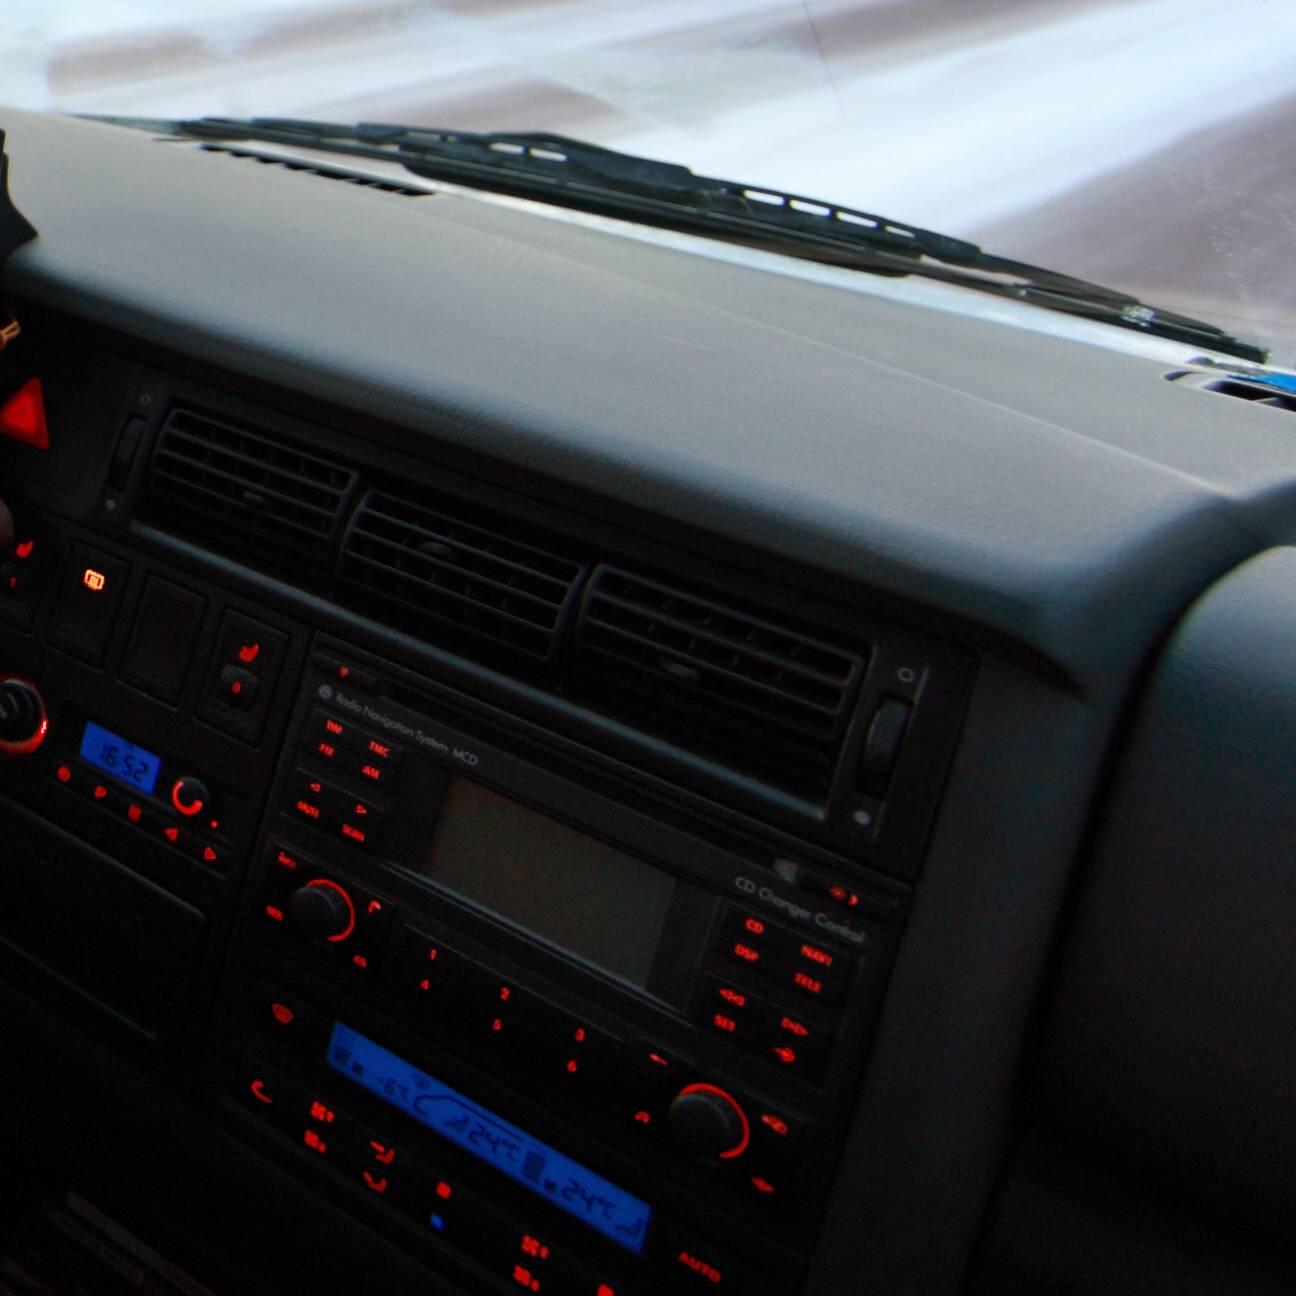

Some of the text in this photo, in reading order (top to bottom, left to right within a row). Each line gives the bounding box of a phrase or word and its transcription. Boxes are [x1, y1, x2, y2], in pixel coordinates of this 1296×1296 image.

[336, 692, 479, 766] Radio Navigation System MCD
[368, 740, 391, 759] TMC
[360, 764, 382, 781] AM
[735, 876, 865, 944] CD Changer Control
[743, 917, 766, 935] CD
[499, 984, 511, 1002] 2
[575, 1025, 586, 1042] 3
[678, 1251, 721, 1283] AUTO
